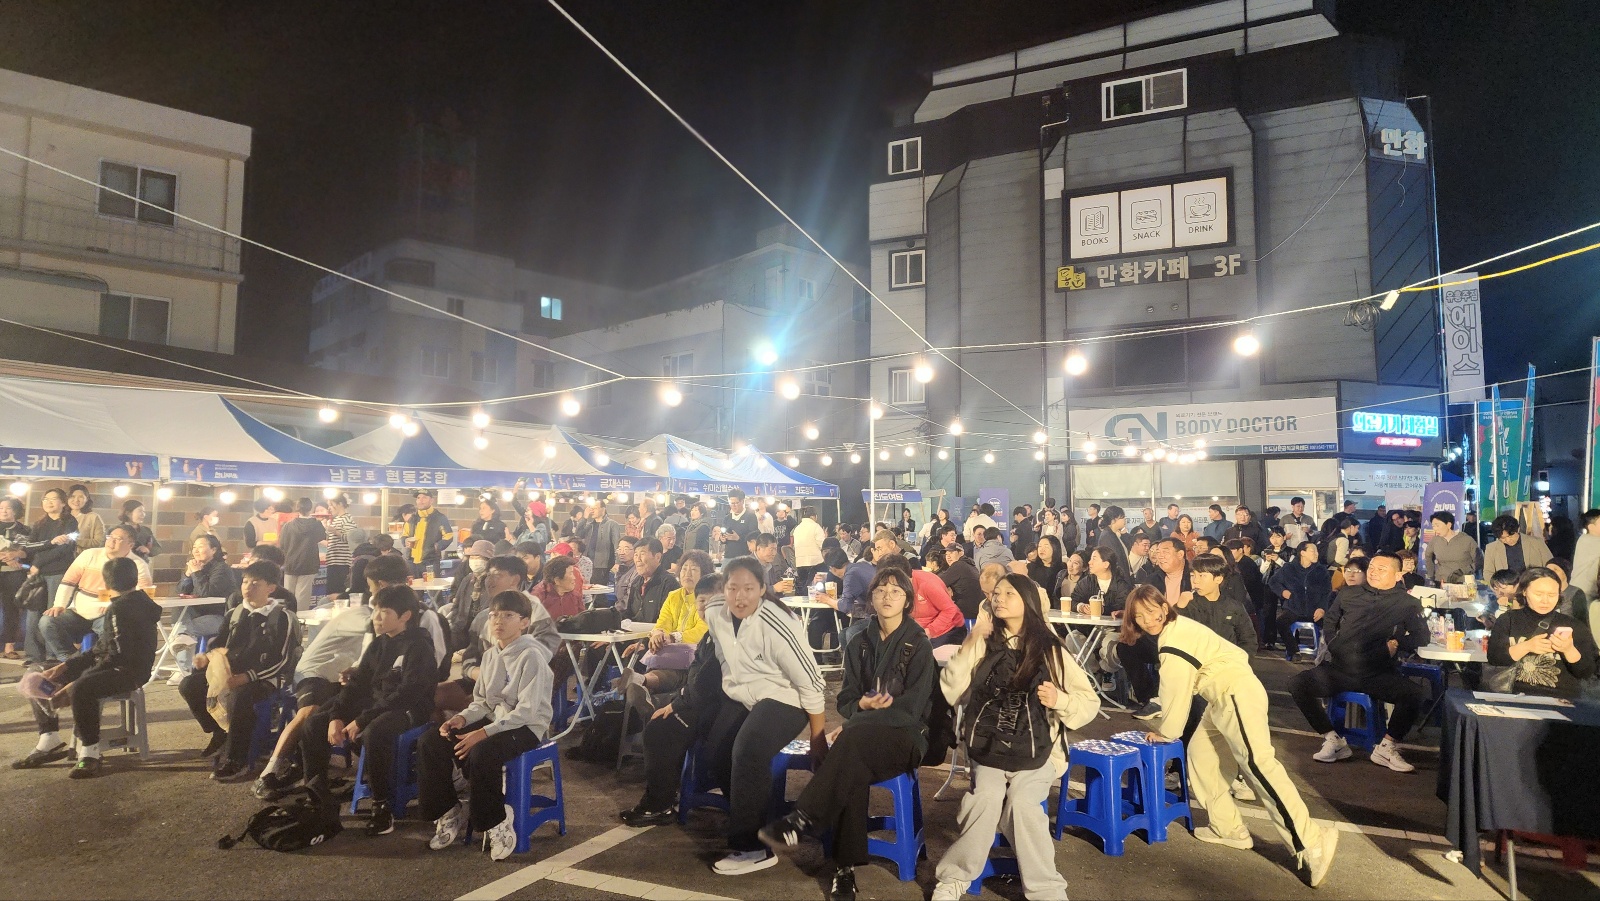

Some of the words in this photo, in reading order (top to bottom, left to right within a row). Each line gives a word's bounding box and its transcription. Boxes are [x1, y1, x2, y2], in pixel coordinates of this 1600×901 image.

[1381, 128, 1428, 160] 만화
[1132, 230, 1161, 241] SNACK
[1188, 224, 1214, 234] DRINK
[1081, 236, 1109, 247] BOOKS
[1096, 255, 1190, 288] 만화카페
[1213, 253, 1241, 278] 3F
[1445, 288, 1479, 303] 유흥주점
[1450, 303, 1481, 376] 에이스
[1175, 418, 1222, 435] BODY
[1227, 415, 1298, 434] DOCTOR
[26, 454, 67, 473] 커피
[385, 469, 449, 485] 협동조합
